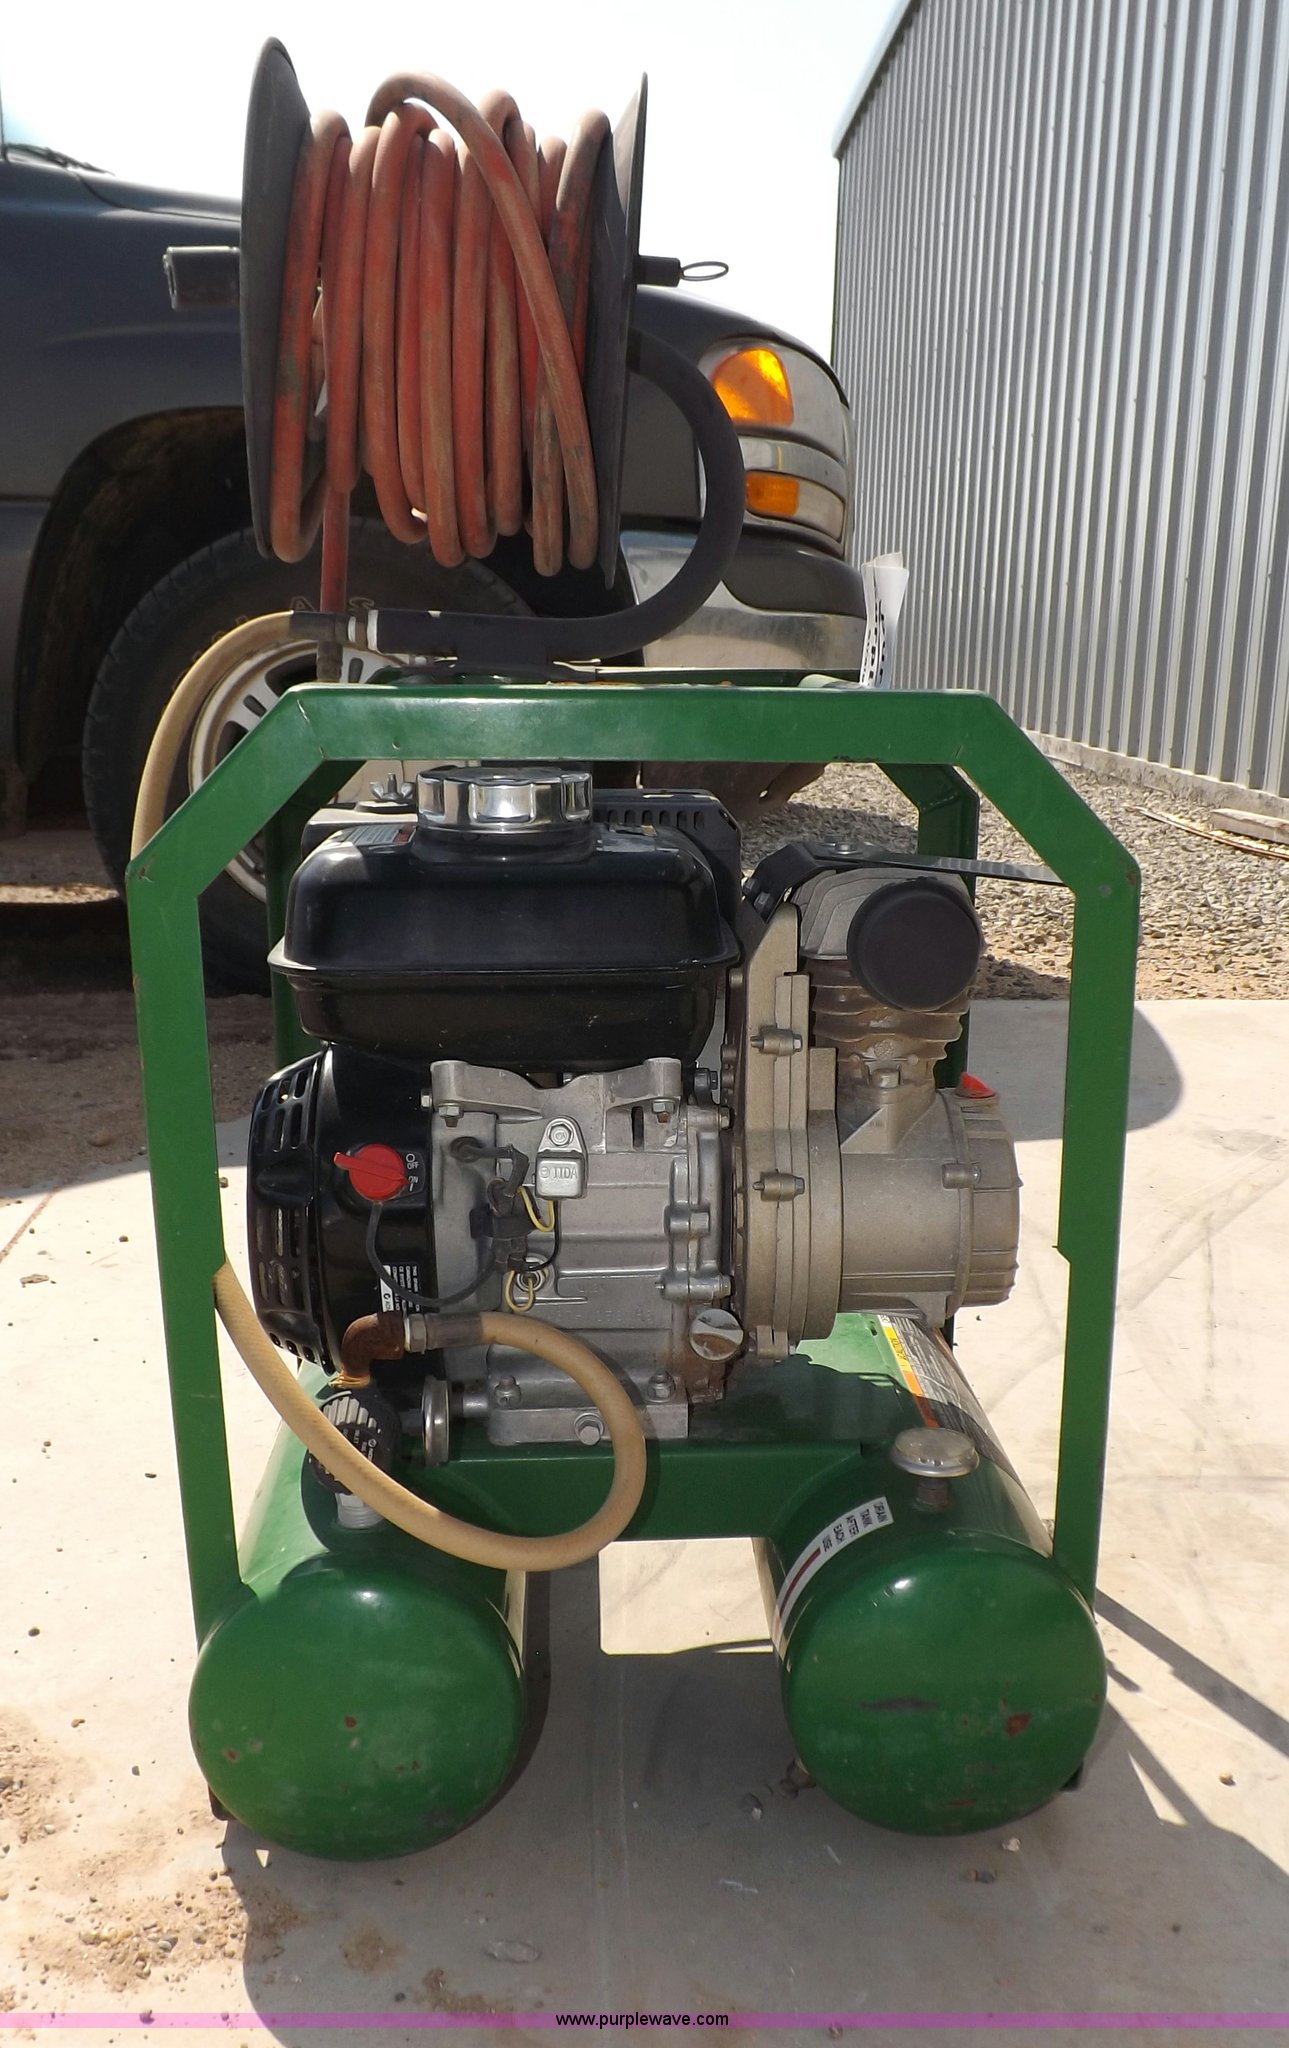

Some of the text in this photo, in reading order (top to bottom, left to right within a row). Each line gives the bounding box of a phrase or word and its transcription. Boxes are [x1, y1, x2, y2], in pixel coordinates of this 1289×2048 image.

[407, 1161, 419, 1170] OFF
[408, 1175, 419, 1184] ON
[860, 1509, 873, 1528] TANK
[873, 1502, 888, 1522] DRAIN
[833, 1524, 845, 1544] EACH
[846, 1515, 859, 1537] AFTER
[822, 1534, 832, 1552] USE
